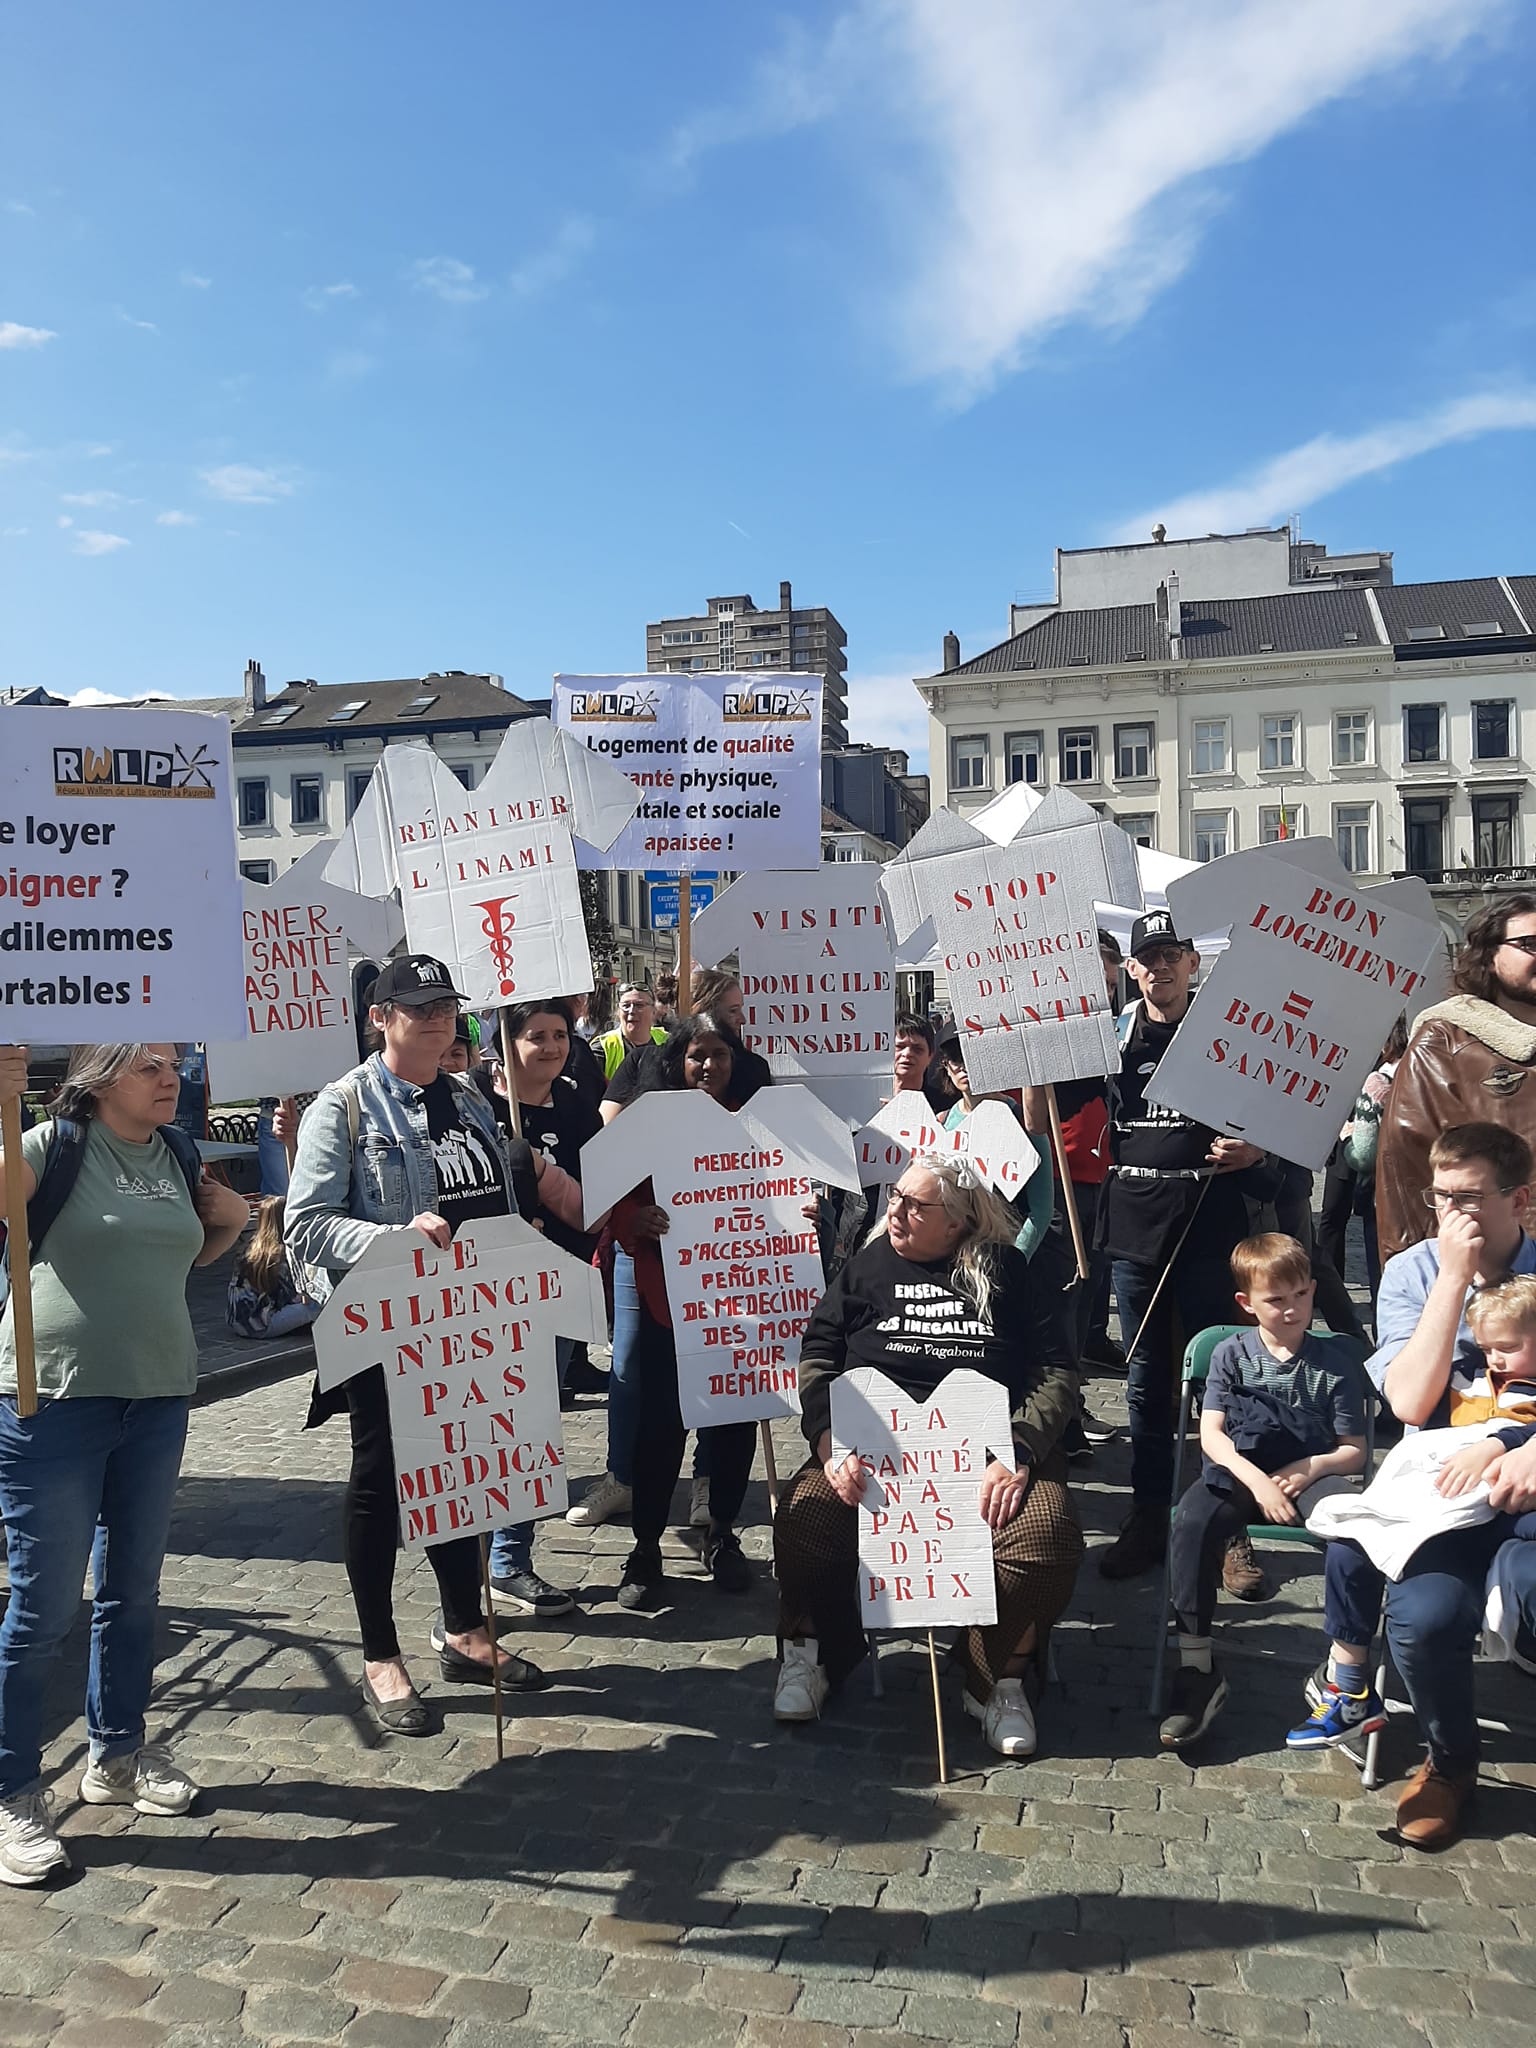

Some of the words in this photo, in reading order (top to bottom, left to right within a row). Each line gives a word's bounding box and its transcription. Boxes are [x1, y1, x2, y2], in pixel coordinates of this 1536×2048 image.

[571, 694, 635, 716] RWLP
[723, 694, 789, 716] RWLP
[588, 736, 688, 758] Logement
[693, 736, 718, 753] de
[722, 734, 794, 758] qualité
[54, 746, 173, 787] RWLP
[680, 769, 778, 792] physique,
[400, 795, 568, 844] RÉANIMER
[686, 803, 706, 818] et
[712, 801, 781, 819] sociale
[26, 816, 115, 854] loyer
[644, 834, 722, 856] apaisée
[728, 833, 734, 850] !
[412, 845, 554, 889] L'INAMI
[111, 869, 129, 897] ?
[954, 871, 1057, 912] STOP
[994, 911, 1028, 934] AU
[1305, 887, 1386, 938] BON
[0, 922, 173, 951] dilemmes
[820, 938, 837, 957] A
[945, 929, 1093, 972] COMMERCE
[1249, 903, 1427, 997] LOGEMENT
[252, 935, 342, 972] SANTE
[0, 976, 130, 1005] rtables
[143, 976, 151, 1004] !
[292, 969, 331, 998] LA
[743, 971, 890, 996] DOMICILE
[978, 975, 1014, 997] DE
[1032, 966, 1069, 988] LA
[749, 1001, 856, 1025] INDIS
[965, 993, 1101, 1039] SANTE
[745, 1032, 890, 1054] PENSABLE
[1224, 998, 1349, 1071] BONNE
[1206, 1038, 1331, 1108] SANTE
[411, 1238, 478, 1278] LE
[343, 1270, 563, 1336] SILENCE
[683, 1301, 708, 1321] DE
[904, 1301, 965, 1318] CONTRE
[702, 1324, 747, 1346] DES
[903, 1319, 995, 1336] INEGALITES
[733, 1345, 785, 1369] POUR
[923, 1343, 985, 1359] Vagabond
[420, 1364, 528, 1417] PAS
[440, 1408, 515, 1454] UN
[890, 1408, 948, 1432] LA
[857, 1438, 972, 1478] SANTÉ
[885, 1479, 941, 1505] N'A
[408, 1474, 554, 1541] MENT
[871, 1507, 955, 1535] PAS
[890, 1540, 943, 1565] DE
